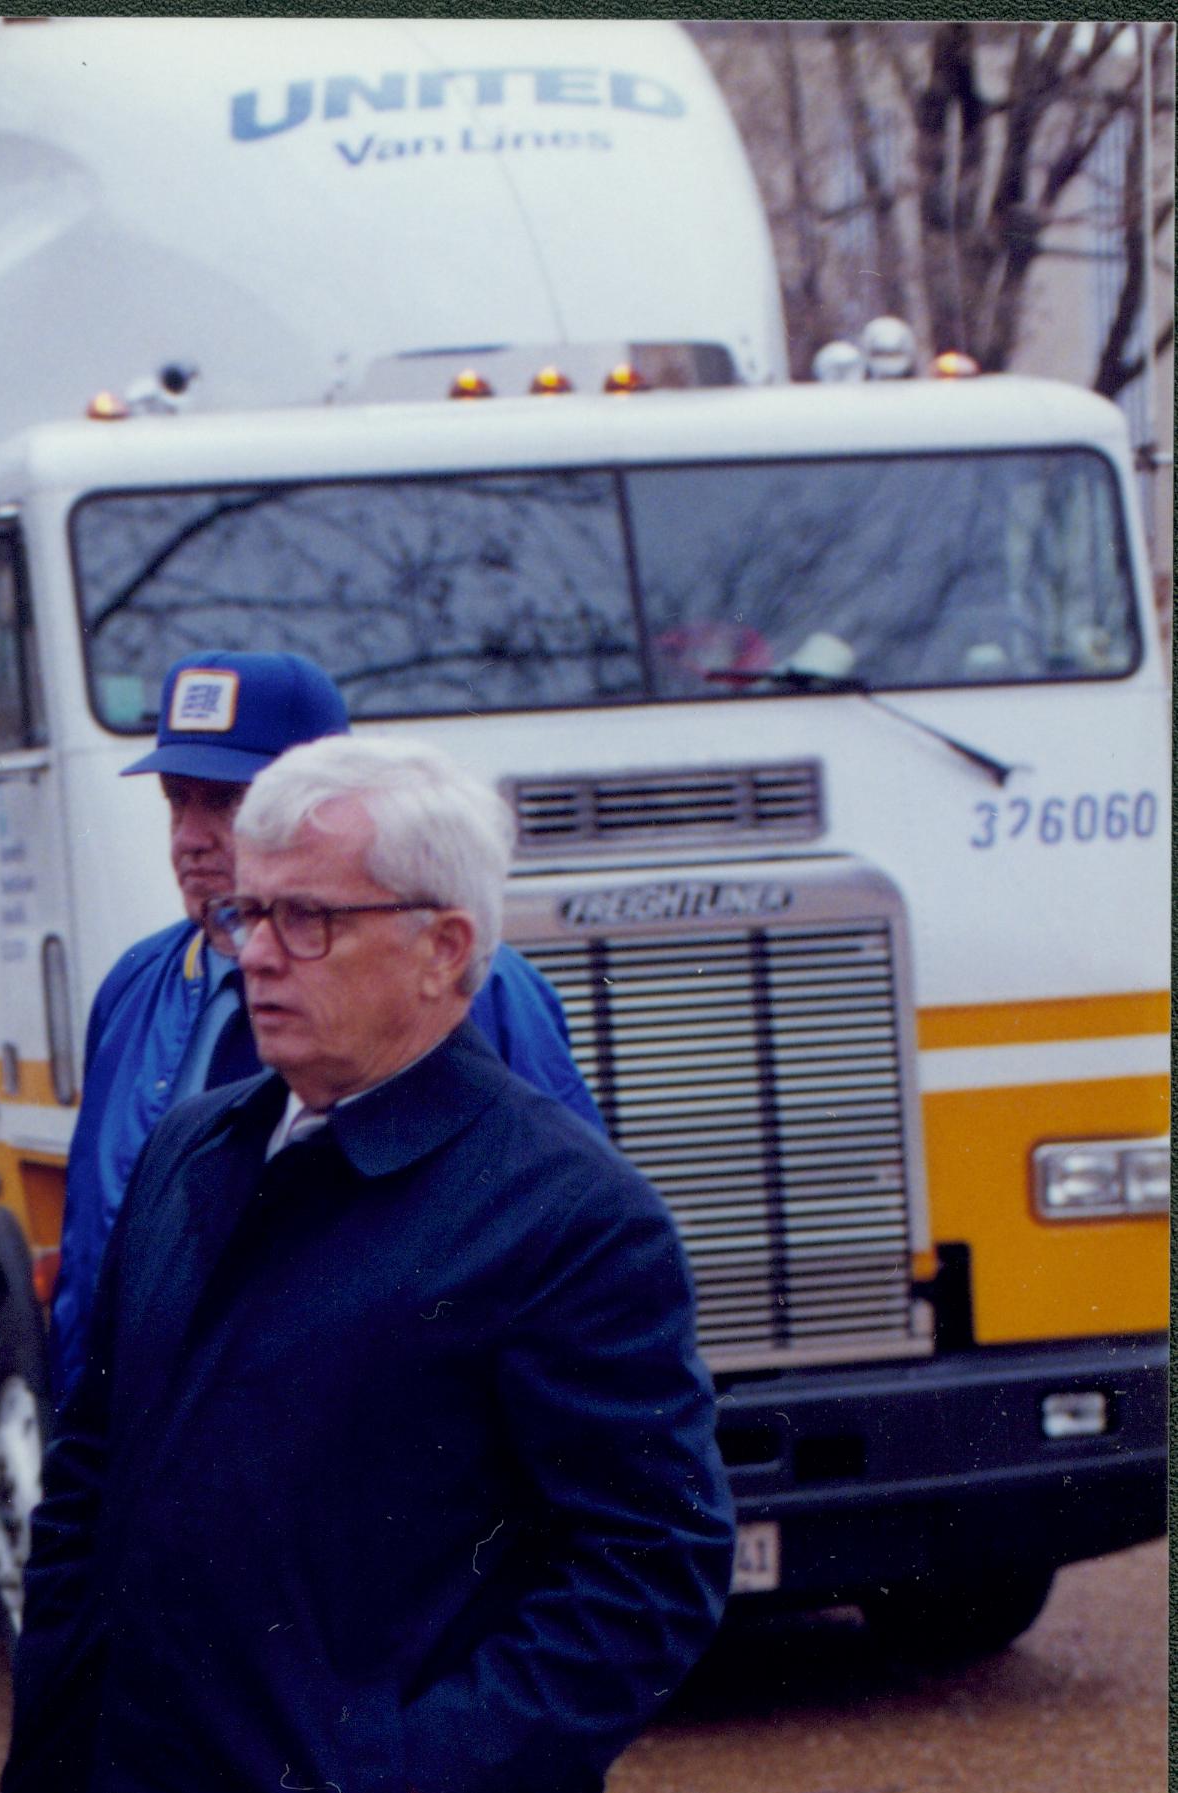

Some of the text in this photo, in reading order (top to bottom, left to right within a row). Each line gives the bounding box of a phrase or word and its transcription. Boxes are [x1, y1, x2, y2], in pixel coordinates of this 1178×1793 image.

[230, 66, 686, 142] UNITED
[334, 128, 612, 167] Van Lines
[970, 790, 1158, 848] 376060
